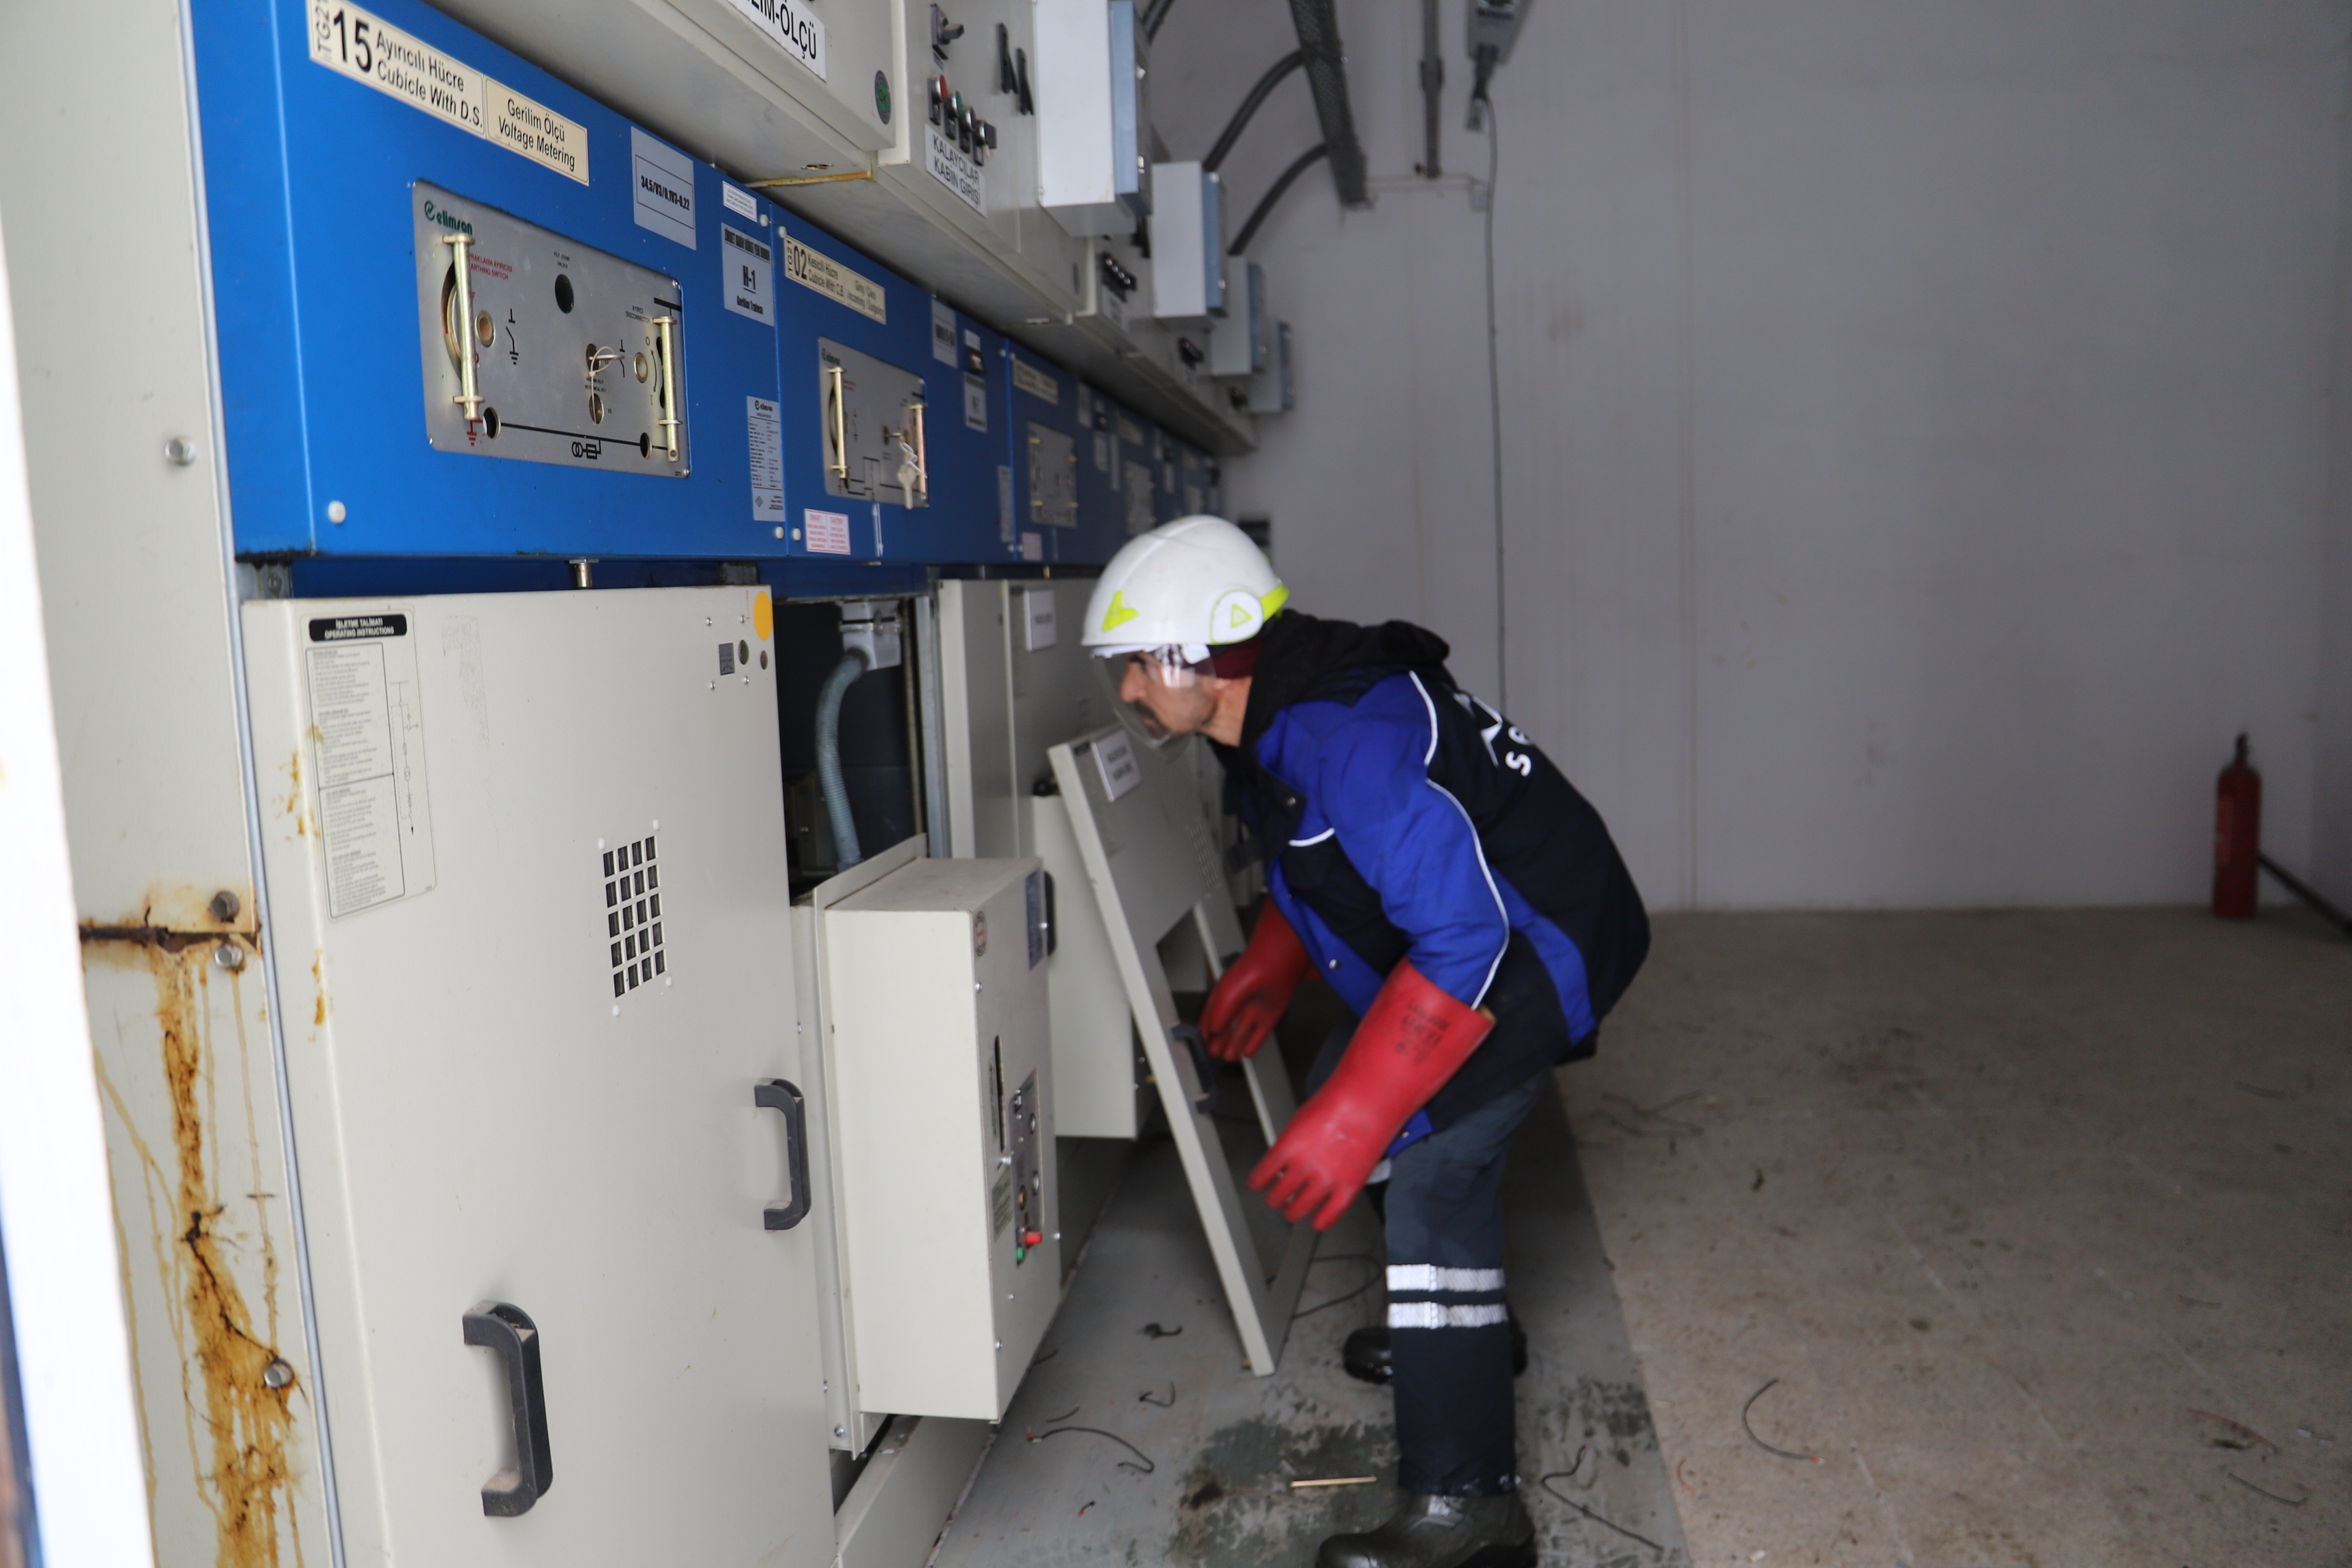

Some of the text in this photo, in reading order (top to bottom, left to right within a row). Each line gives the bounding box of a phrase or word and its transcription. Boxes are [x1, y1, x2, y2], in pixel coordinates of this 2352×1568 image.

[334, 9, 373, 73] 15
[378, 61, 484, 128] Cubicle With D.S.
[428, 55, 465, 93] Hücre
[498, 115, 575, 172] Voltage Metering
[507, 98, 565, 143] Gerilim Ölçü
[794, 245, 807, 280] 02
